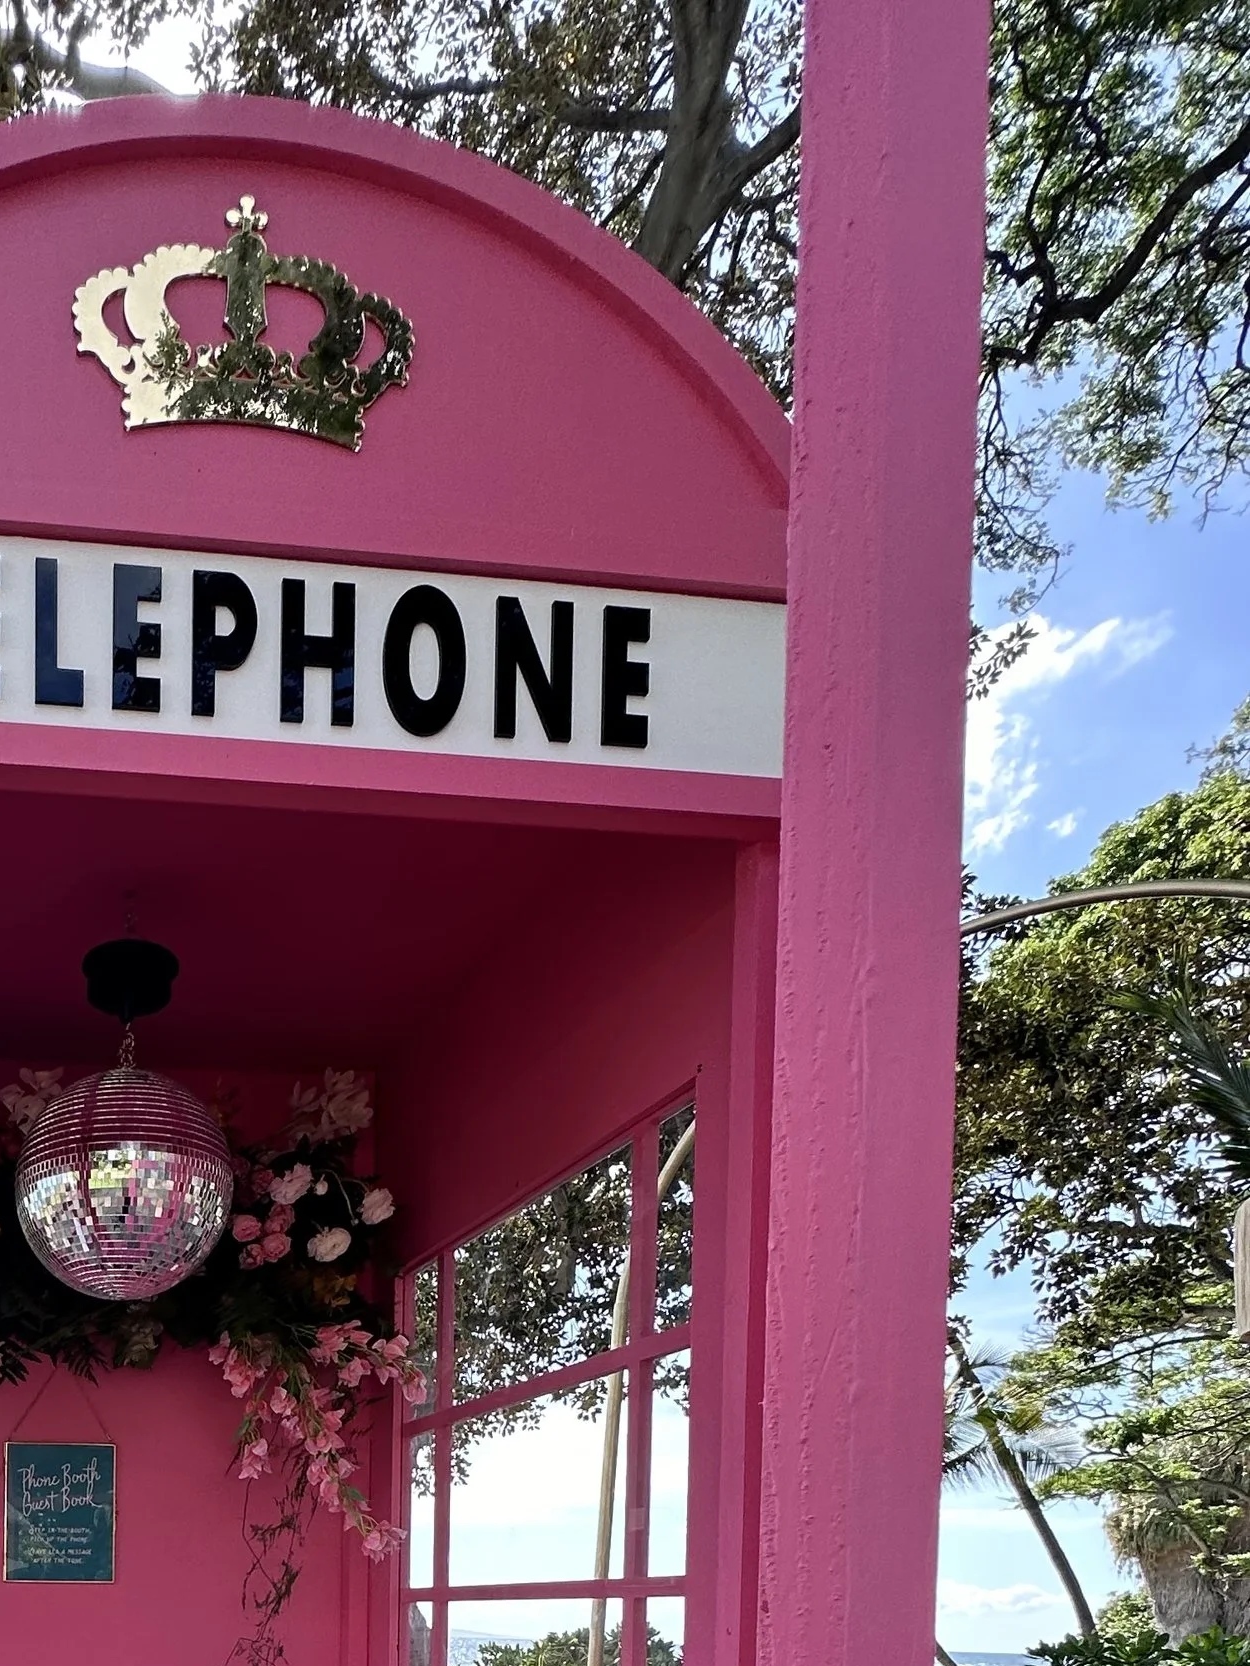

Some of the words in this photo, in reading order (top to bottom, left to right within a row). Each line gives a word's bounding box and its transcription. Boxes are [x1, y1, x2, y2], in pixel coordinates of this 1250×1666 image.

[17, 1463, 61, 1492] Phone
[61, 1457, 101, 1487] Booth
[22, 1491, 59, 1517] Guest
[61, 1481, 102, 1513] Book
